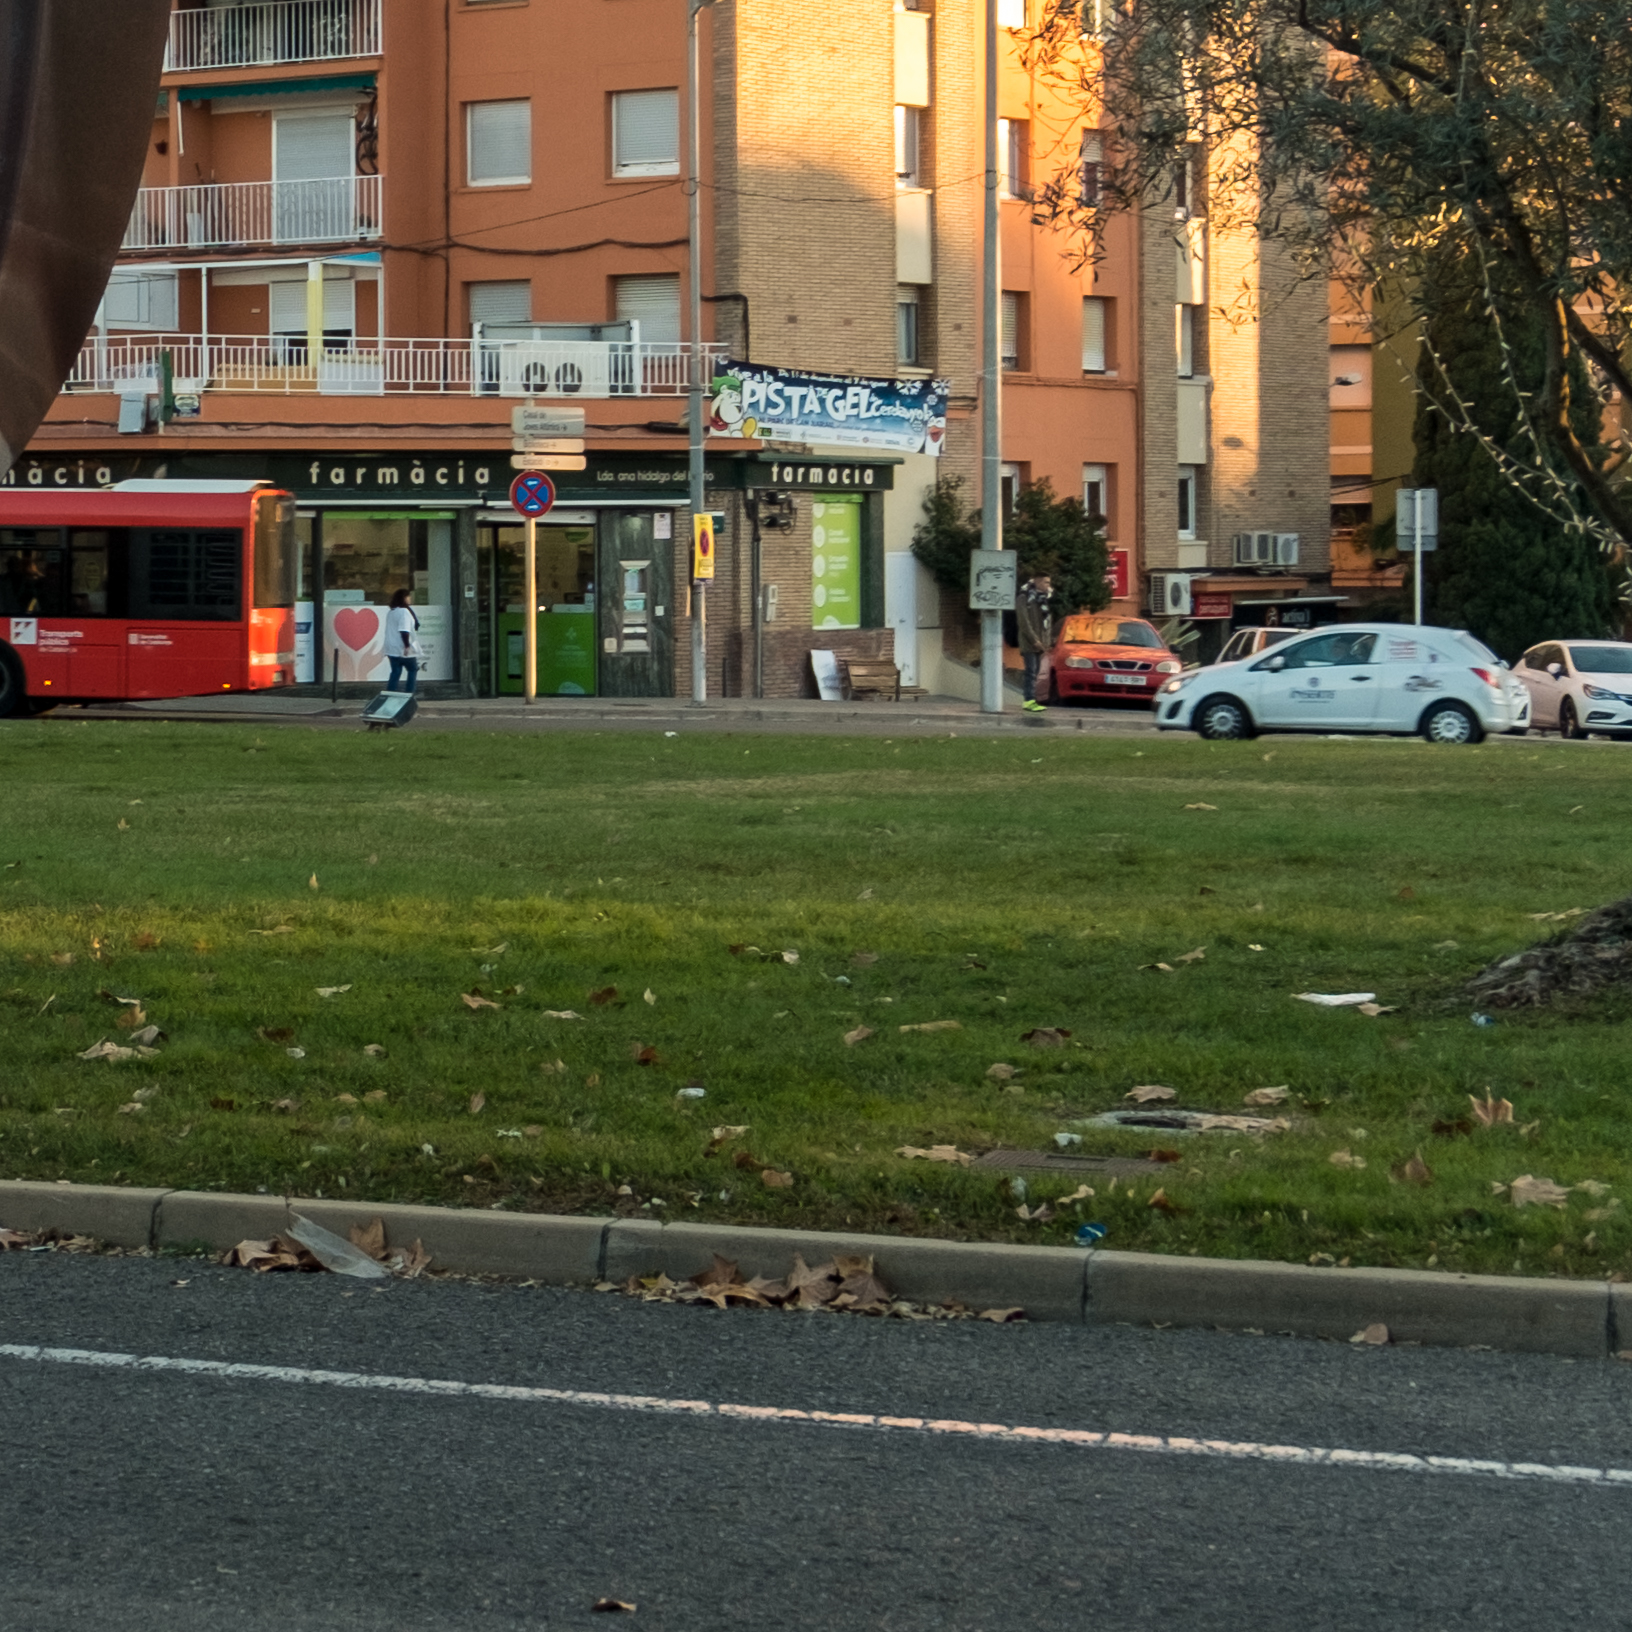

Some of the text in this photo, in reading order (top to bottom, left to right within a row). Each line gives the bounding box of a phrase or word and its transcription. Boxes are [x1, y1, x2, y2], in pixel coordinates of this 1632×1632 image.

[742, 380, 822, 418] PISTA
[825, 385, 872, 421] GEL
[1, 459, 111, 485] màcia
[309, 459, 489, 484] farmàcia
